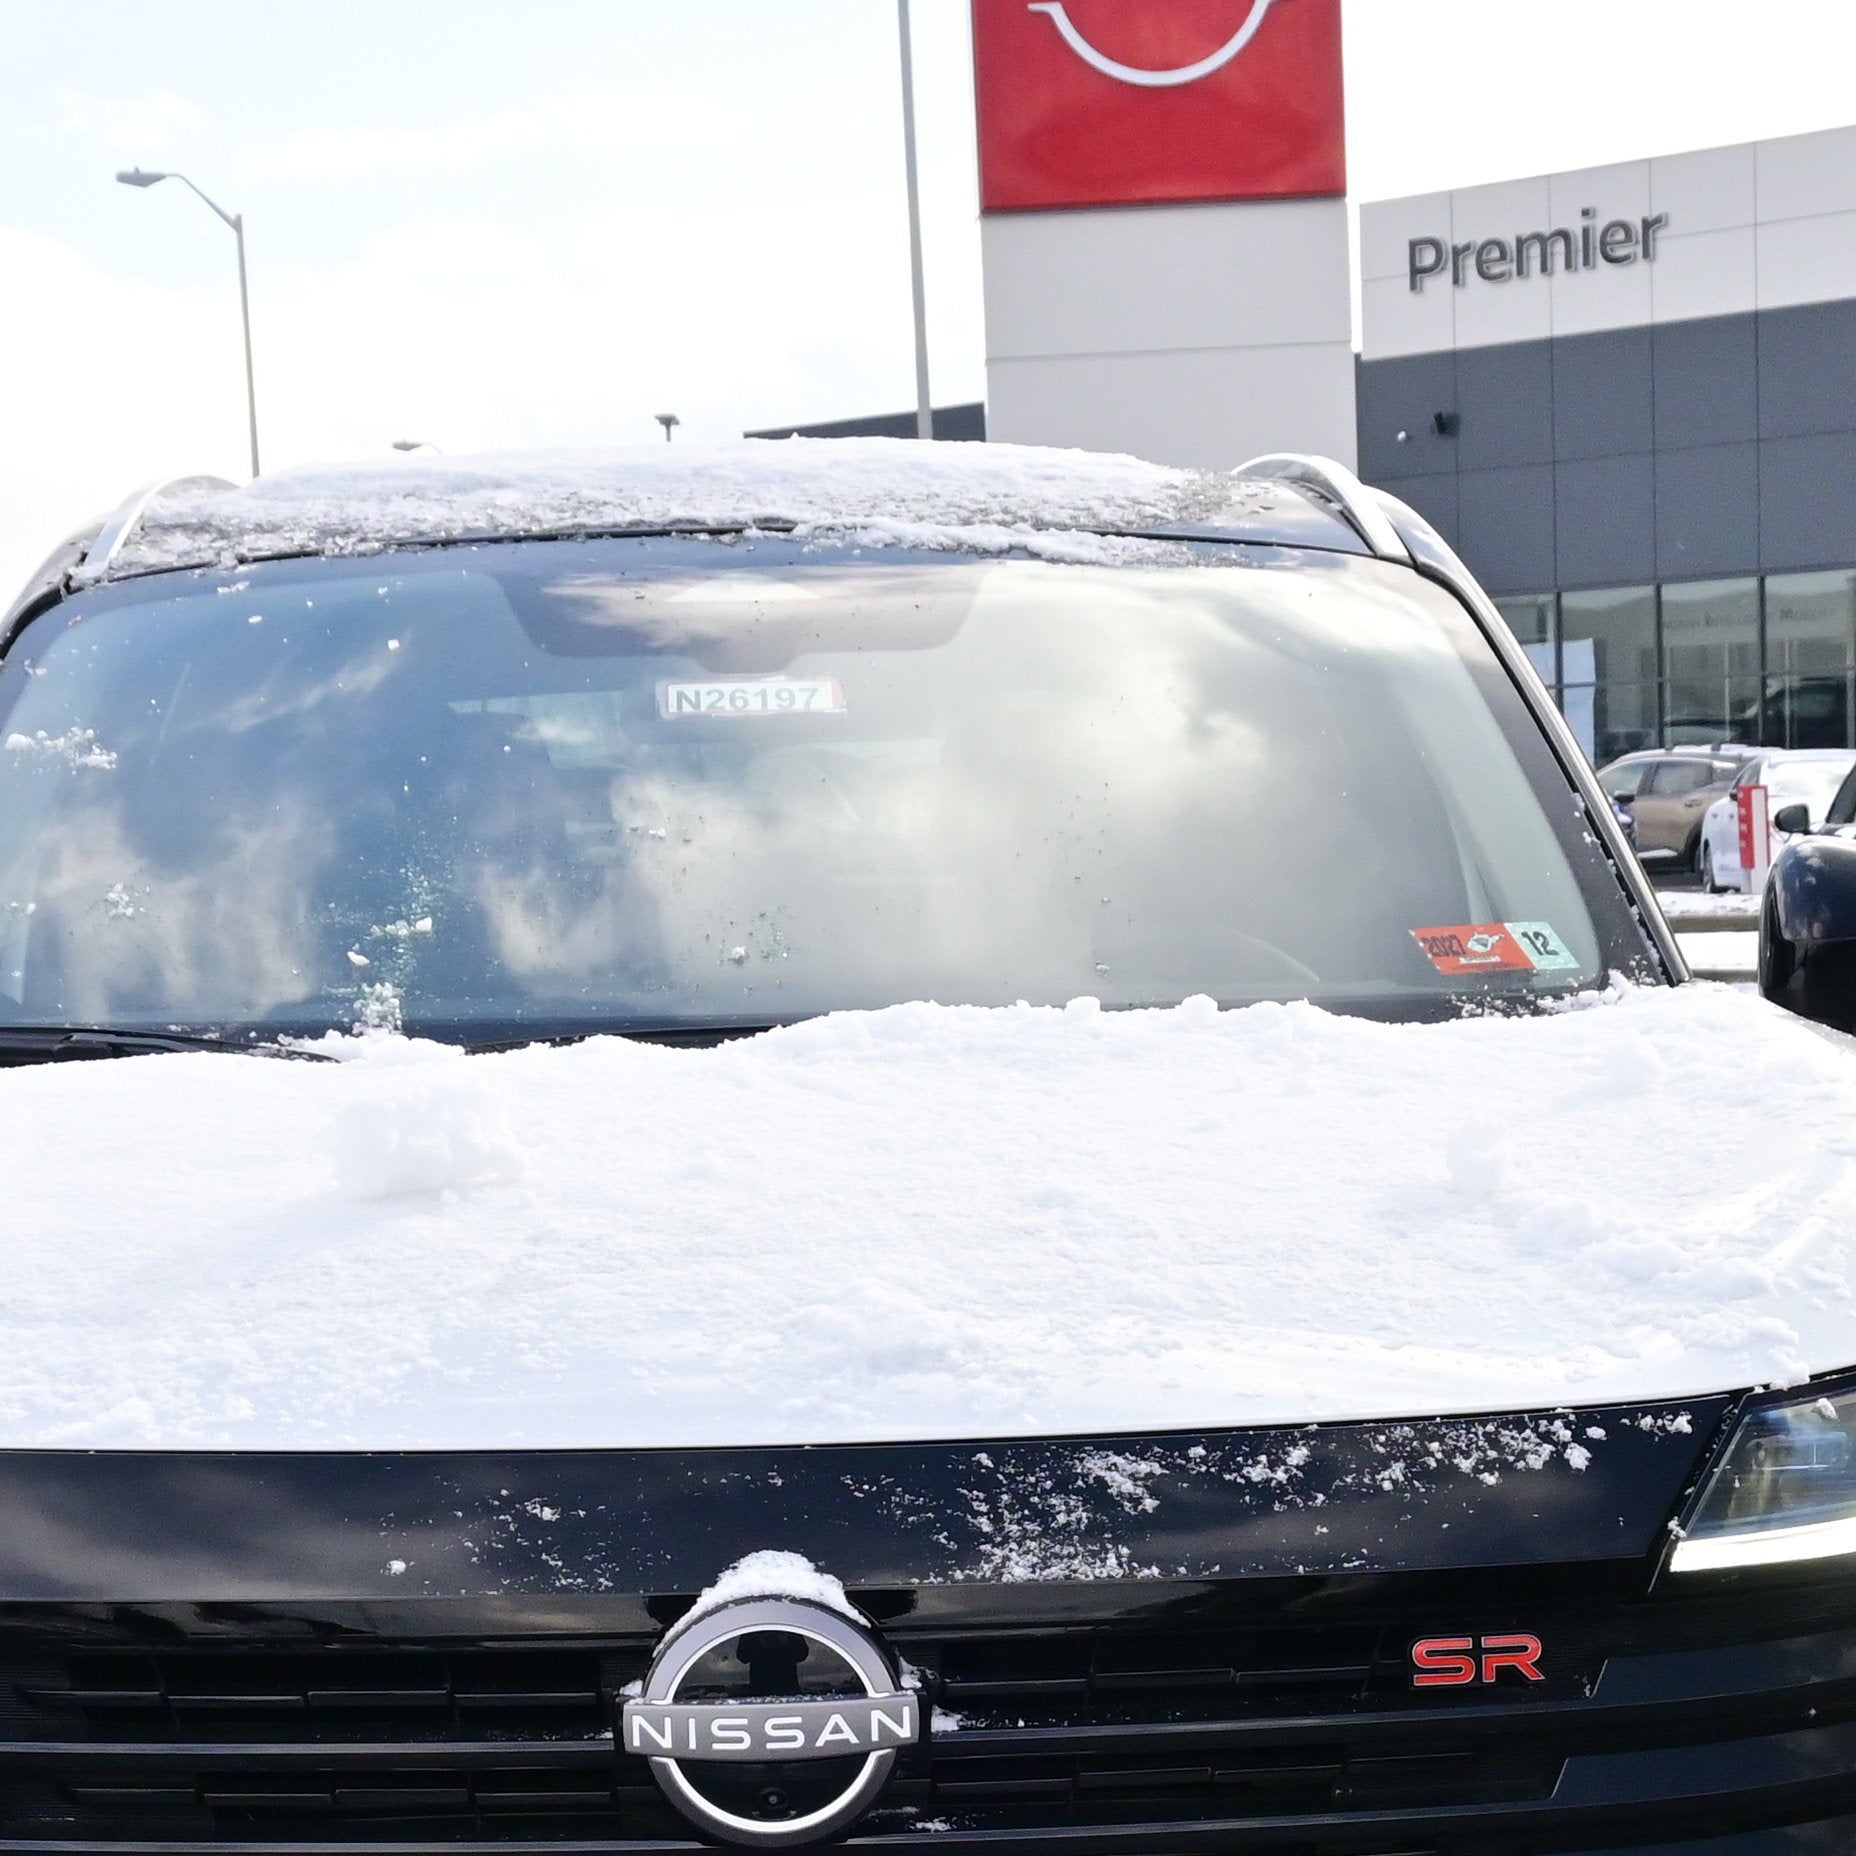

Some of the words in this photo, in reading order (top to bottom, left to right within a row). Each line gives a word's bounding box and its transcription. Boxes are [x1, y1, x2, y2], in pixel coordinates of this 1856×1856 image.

[1408, 205, 1668, 292] Premier
[675, 687, 820, 711] N26197
[1421, 934, 1466, 957] 2027
[1521, 931, 1559, 956] 12
[1412, 1633, 1546, 1687] SR
[632, 1705, 911, 1750] NISSAN
